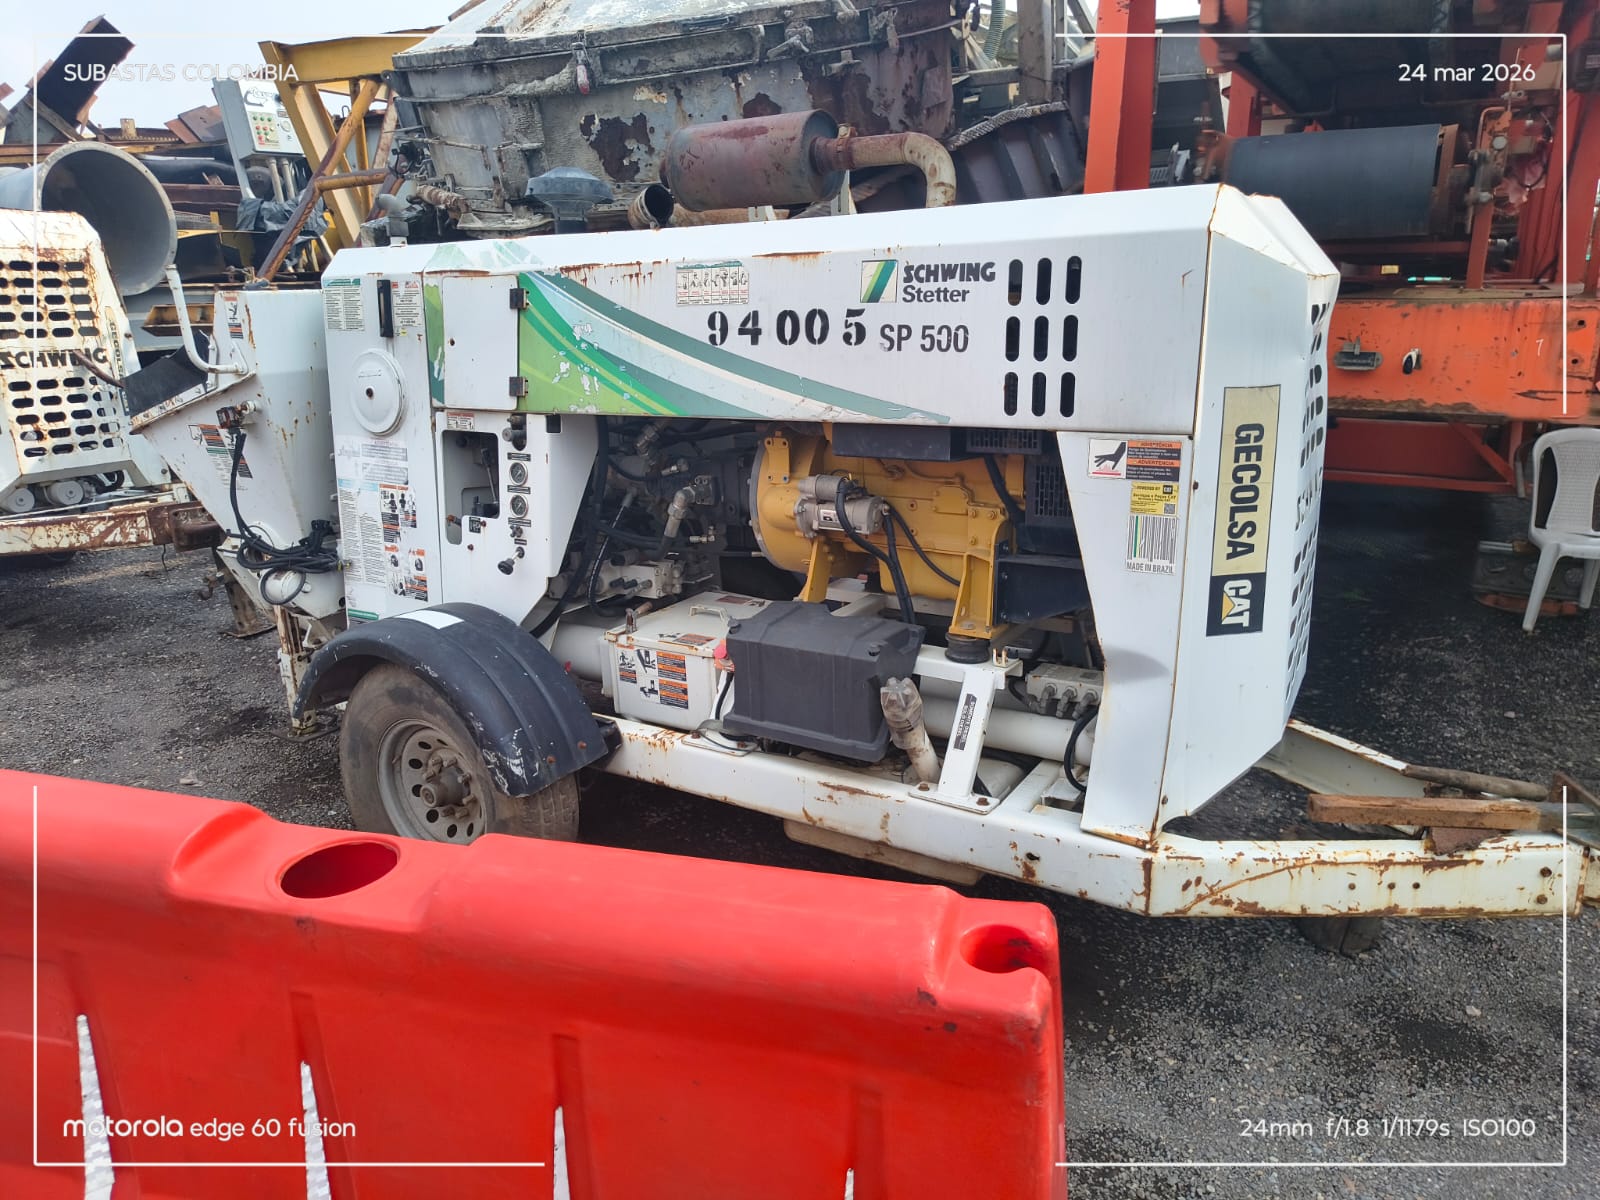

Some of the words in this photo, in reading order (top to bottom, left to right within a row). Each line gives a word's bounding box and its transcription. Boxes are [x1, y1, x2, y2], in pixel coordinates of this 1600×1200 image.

[902, 262, 996, 283] SCHWING
[902, 285, 970, 303] Stetter
[880, 324, 912, 352] SP
[920, 324, 969, 352] 500
[1226, 423, 1264, 560] GECOLSA
[1126, 561, 1144, 571] MADE
[1144, 563, 1152, 572] IN
[1153, 564, 1174, 574] BRAZIL
[1221, 579, 1252, 628] CAT
